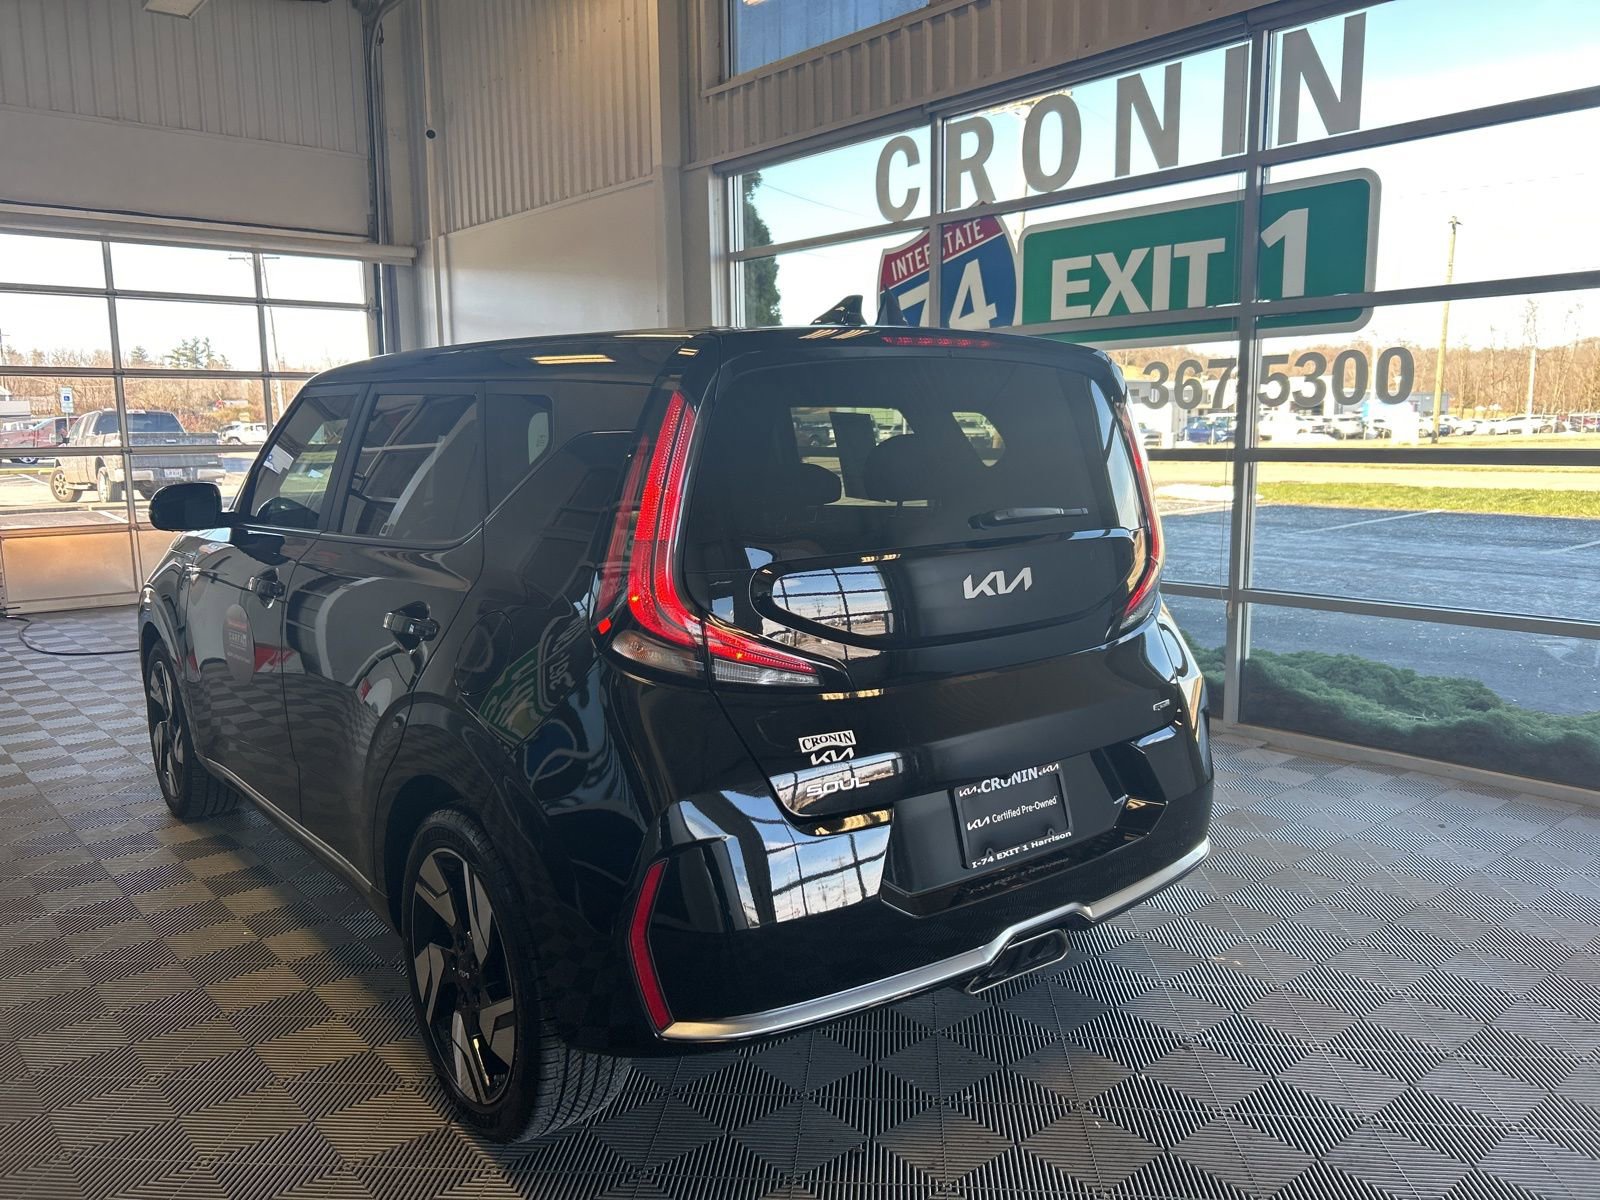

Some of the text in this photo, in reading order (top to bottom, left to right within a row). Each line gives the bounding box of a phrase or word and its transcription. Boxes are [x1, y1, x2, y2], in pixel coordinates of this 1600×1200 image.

[875, 12, 1367, 222] CRONIN
[1050, 207, 1309, 321] EXIT 1
[898, 258, 997, 329] 74
[1257, 346, 1415, 407] 5300
[963, 567, 1032, 600] KIA
[802, 732, 853, 751] CRONIN
[810, 747, 855, 766] KIA
[806, 777, 870, 797] SOUL
[966, 796, 1057, 831] KIA Certified Pre-Owned
[971, 831, 1072, 869] I-74 EXIT 1 Harrison
